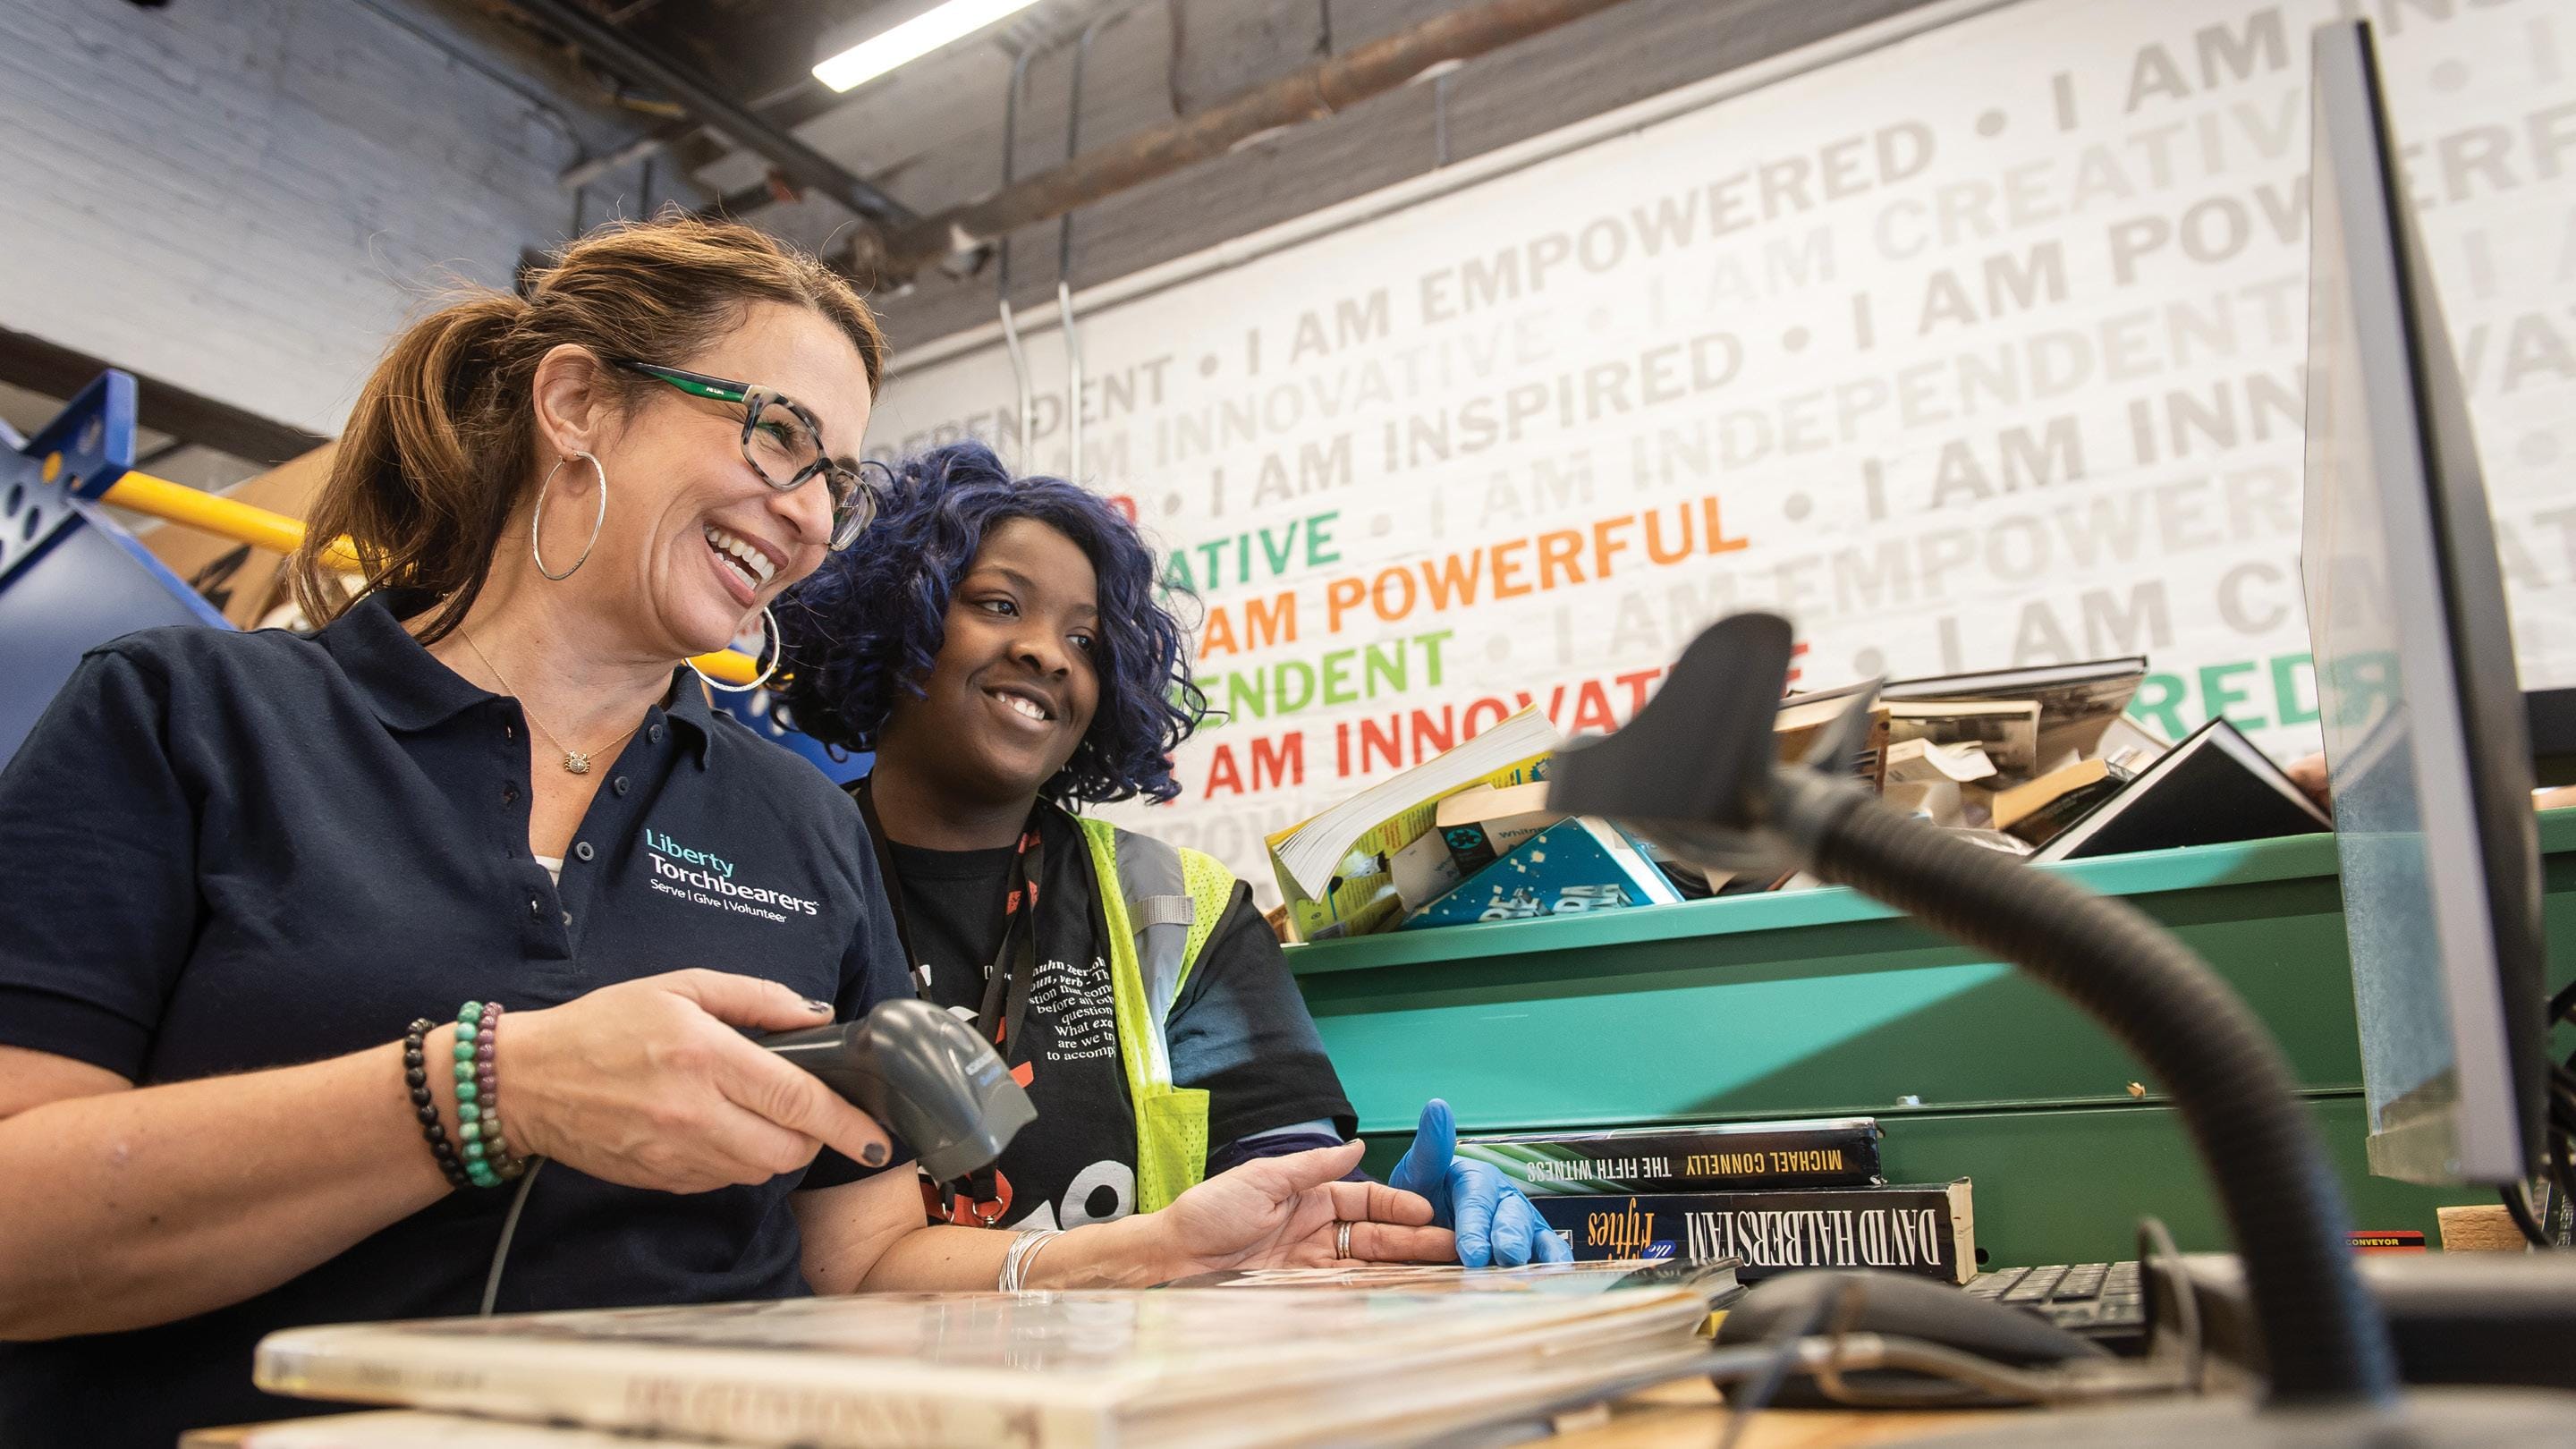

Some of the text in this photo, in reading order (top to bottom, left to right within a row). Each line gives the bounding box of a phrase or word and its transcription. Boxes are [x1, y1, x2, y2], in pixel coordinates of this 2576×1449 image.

[1246, 327, 1259, 375] I
[1292, 289, 1390, 365] AM
[1420, 119, 1937, 326] EMPOWERED
[2052, 71, 2080, 133] I
[2124, 5, 2292, 114] AM
[1156, 309, 1555, 468] INNOVATIVE
[1706, 224, 1837, 313] AM
[1210, 468, 1224, 517] I
[1252, 432, 1352, 505] AM
[1383, 331, 1745, 474] INSPIRED
[1852, 291, 1875, 352] I
[1918, 240, 2068, 337] AM
[1478, 449, 1595, 529] AM
[1632, 272, 2304, 492] INDEPENDENT
[1198, 590, 1298, 661] AM
[1327, 495, 1750, 634] POWERFUL
[1861, 456, 1888, 522] I
[1930, 414, 2086, 510] AM
[1203, 731, 1305, 801] AM
[2011, 578, 2177, 669] AM
[646, 828, 734, 877] Liberty
[648, 852, 819, 916] Torchbearers
[650, 878, 787, 923] Serve Give Volunteer
[1059, 974, 1083, 987] verb
[1059, 985, 1082, 996] that
[1036, 996, 1076, 1014] before
[1079, 996, 1094, 1005] all
[1061, 1006, 1113, 1026] question
[1054, 1021, 1090, 1037] What
[1057, 1039, 1078, 1048] are
[1080, 1034, 1100, 1047] we
[1046, 1051, 1061, 1061] to
[1527, 1148, 1843, 1182] MICHAEL CONNELLY THE FIFTH WITNESS
[1588, 1197, 1673, 1259] the Fifties
[1684, 1208, 1942, 1267] DAVID HALBERSTAM
[2345, 1238, 2400, 1246] CONVEYOR
